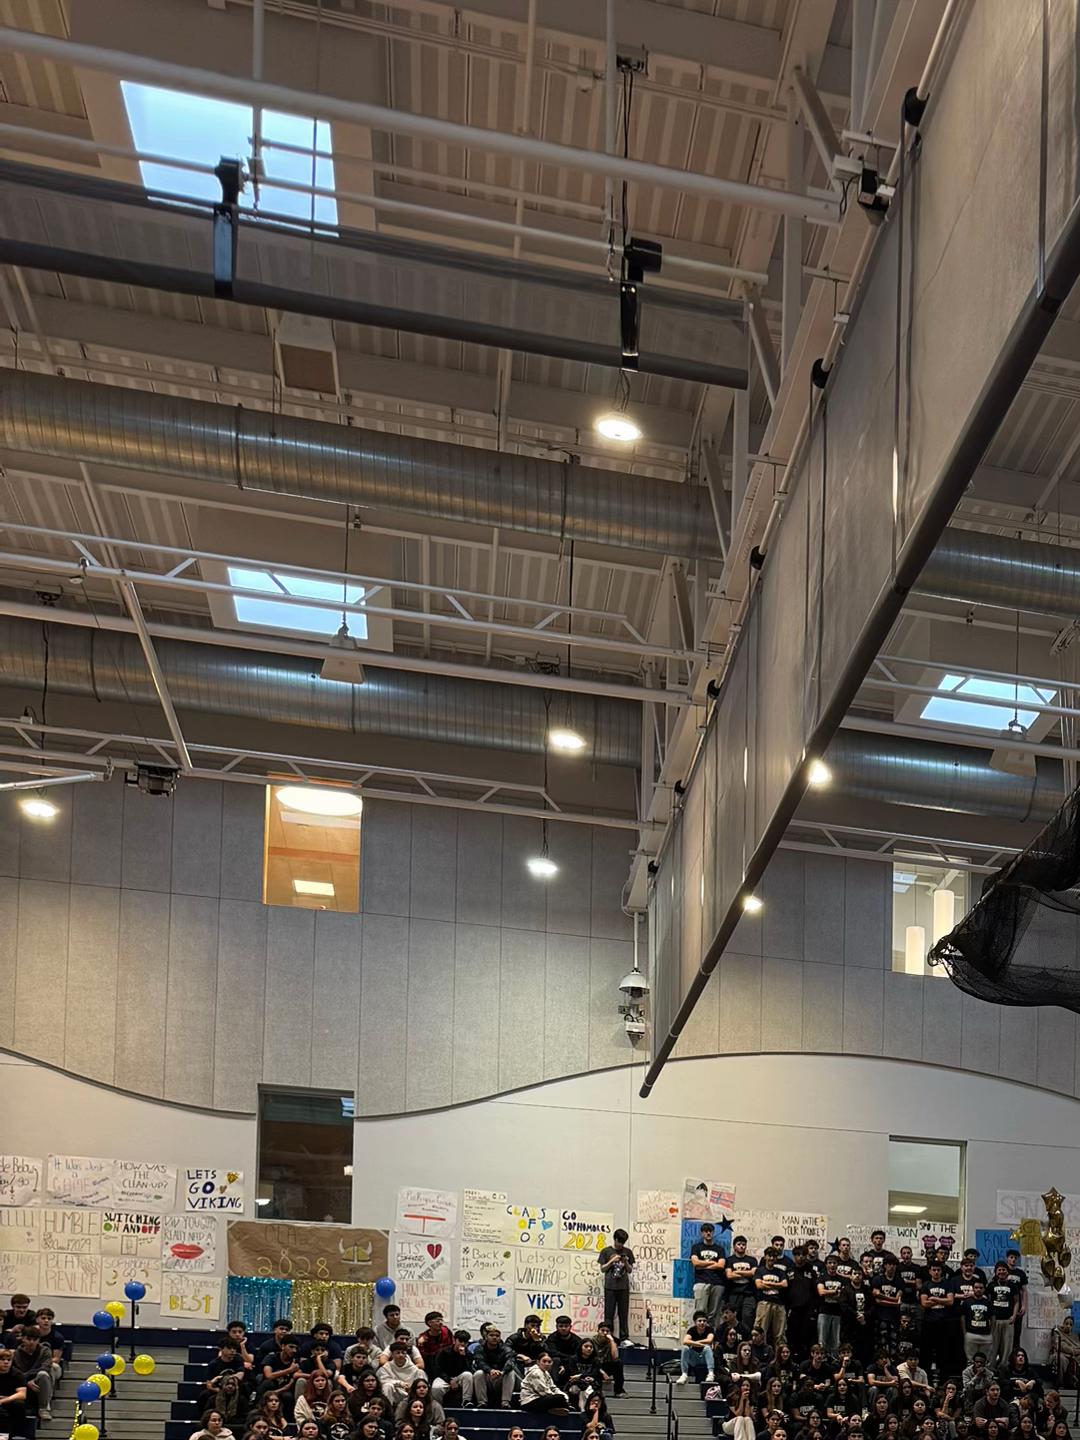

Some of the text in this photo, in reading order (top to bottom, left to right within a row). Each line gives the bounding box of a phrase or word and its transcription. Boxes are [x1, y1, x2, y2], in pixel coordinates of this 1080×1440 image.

[186, 1169, 217, 1180] LETS
[188, 1181, 215, 1195] GO
[186, 1196, 242, 1210] VIKING
[103, 1212, 161, 1226] SWITCHING
[561, 1210, 577, 1221] GO
[781, 1215, 800, 1225] MAN
[103, 1222, 161, 1235] ON AND OFF
[561, 1221, 612, 1234] SOPHOMORES
[633, 1222, 654, 1234] KISS
[897, 1227, 918, 1239] WON
[919, 1222, 957, 1234] SPOT THE
[562, 1231, 607, 1251] 2028
[472, 1249, 500, 1260] Back
[632, 1245, 676, 1260] GOODBYE
[519, 1250, 565, 1269] Lets go
[169, 1294, 214, 1314] BEST
[527, 1293, 566, 1310] VIKES
